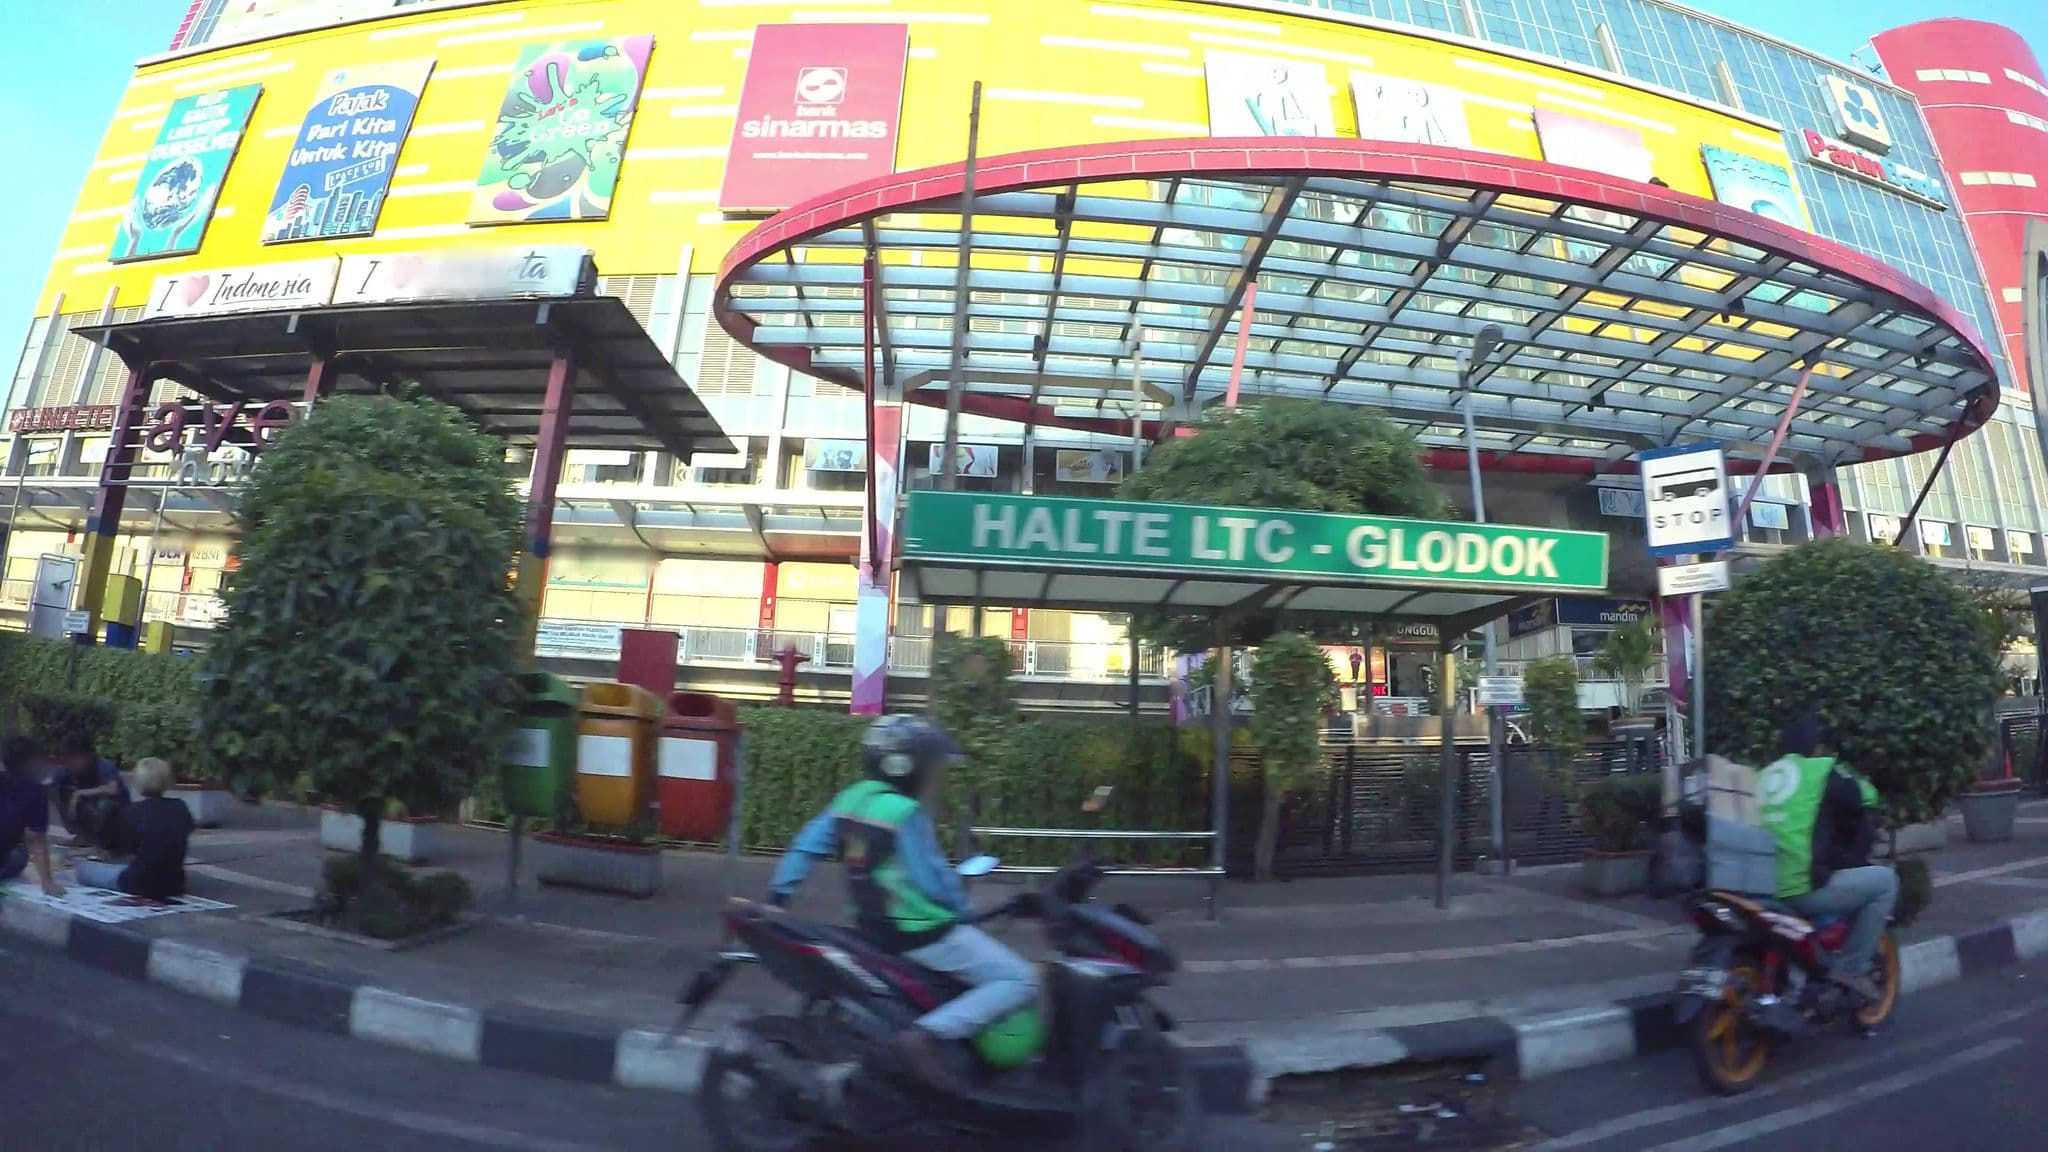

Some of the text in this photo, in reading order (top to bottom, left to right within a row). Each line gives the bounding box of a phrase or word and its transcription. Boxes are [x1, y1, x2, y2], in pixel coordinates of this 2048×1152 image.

[328, 89, 390, 116] Pajak
[306, 117, 397, 142] Dari Kita
[741, 114, 888, 138] sinarmas
[290, 140, 397, 167] Untuk Kita
[356, 260, 382, 294] I
[156, 271, 312, 312] I Indonesia
[1654, 507, 1723, 529] STOP
[972, 503, 1170, 557] HALTE
[1190, 514, 1296, 564] LTC
[1346, 524, 1560, 579] GLODOK
